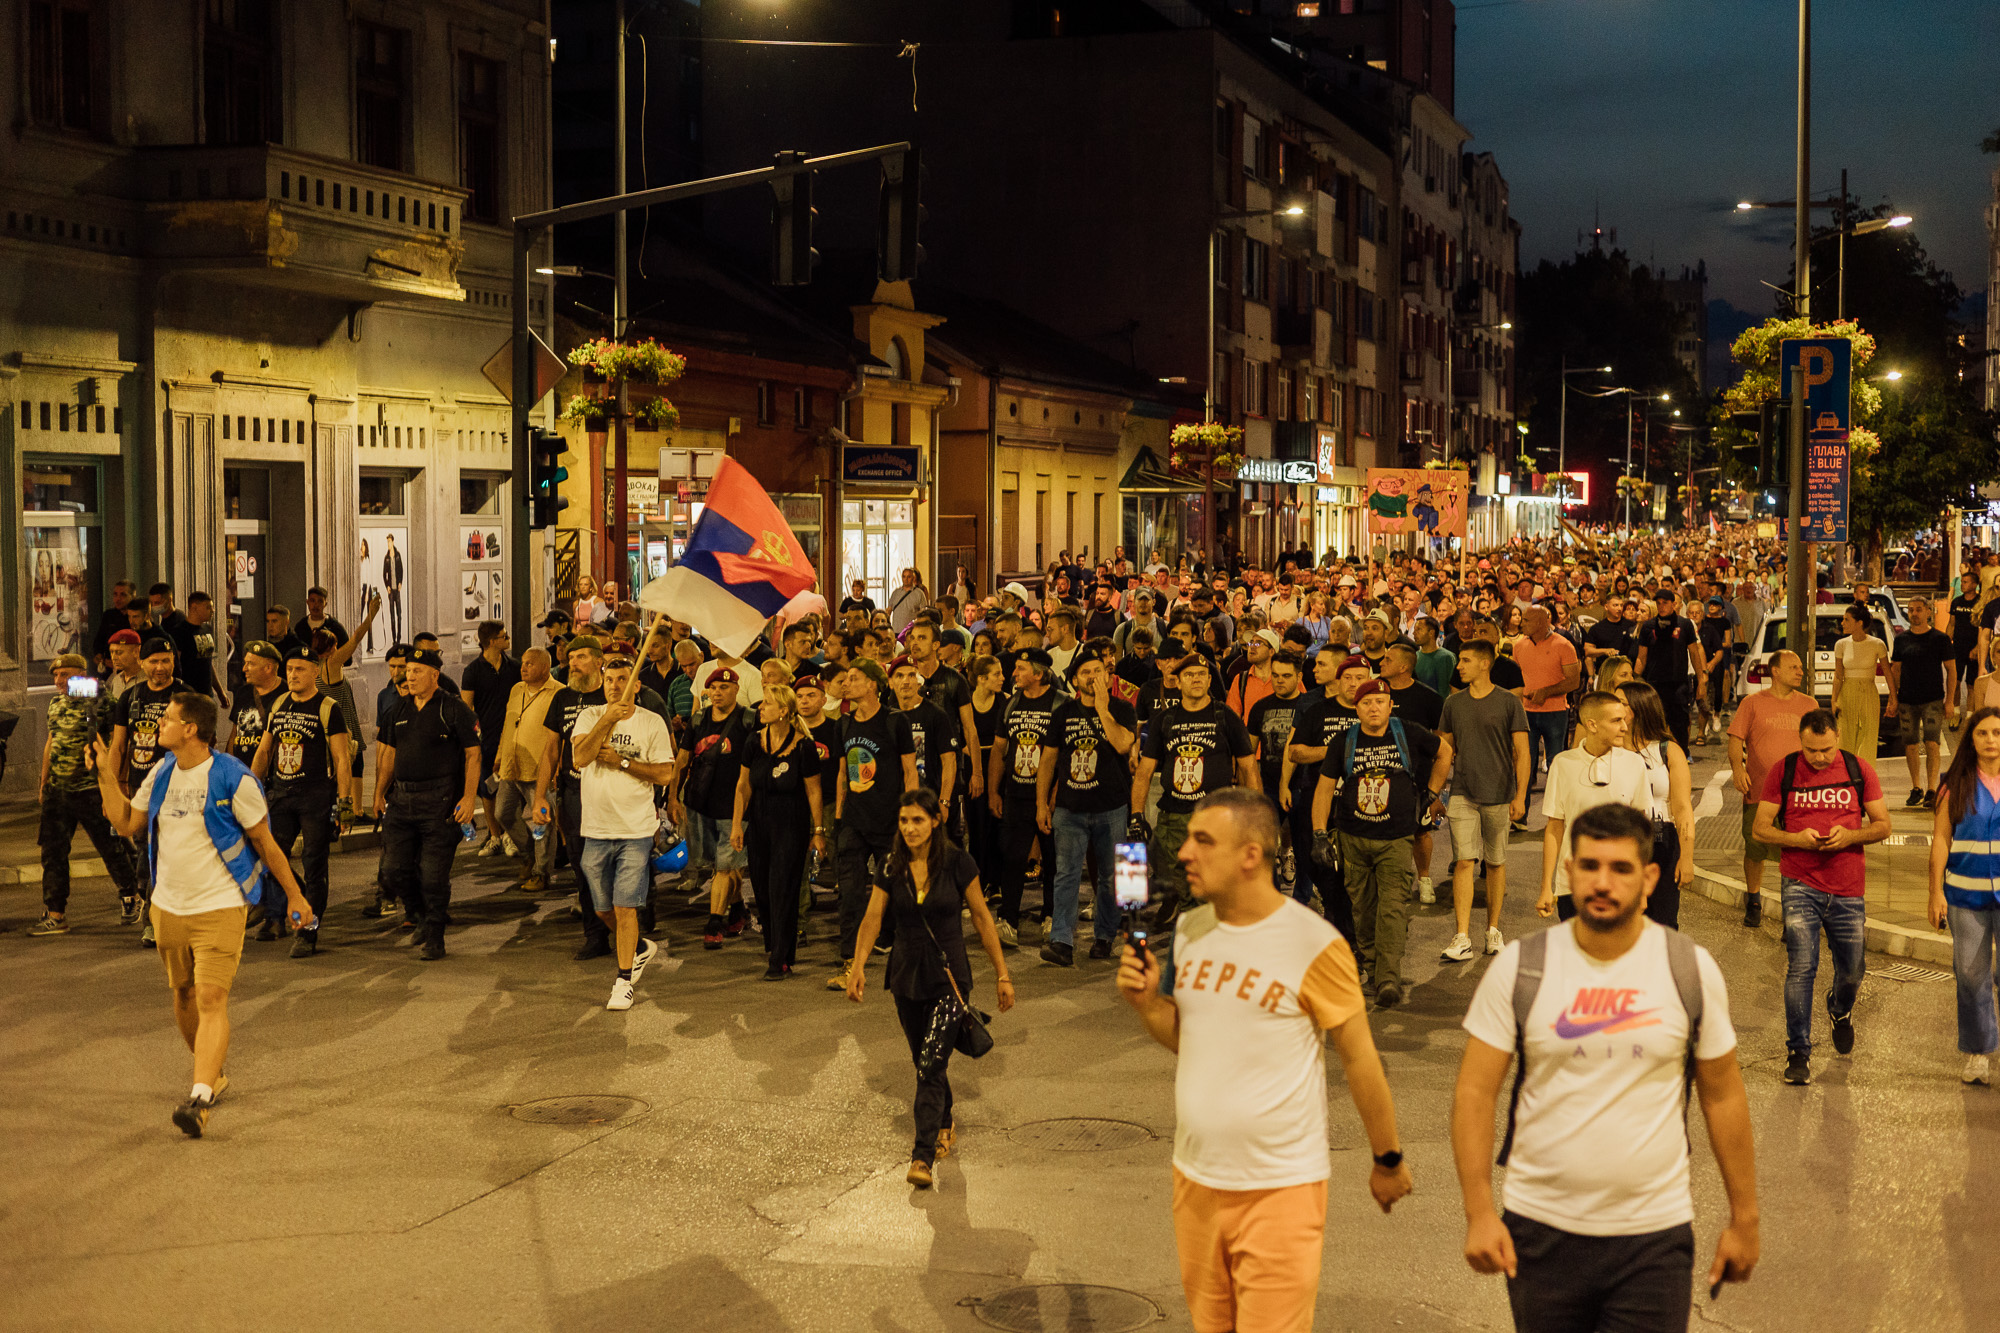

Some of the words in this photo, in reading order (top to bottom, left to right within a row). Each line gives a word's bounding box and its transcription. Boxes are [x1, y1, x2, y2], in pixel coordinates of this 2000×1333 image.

[1800, 346, 1834, 399] P
[1814, 446, 1846, 456] ПЛАВА
[1817, 458, 1842, 469] BLUE
[1020, 723, 1047, 736] ВЕТЕРАН
[857, 736, 880, 753] IZVORA
[1166, 737, 1179, 751] ДАН
[1181, 736, 1216, 749] ВЕТЕРАНА
[1352, 764, 1364, 774] АН
[1366, 760, 1403, 769] ВЕТЕРАН
[1794, 788, 1851, 804] HUGO
[1354, 810, 1390, 823] ВИДОВДАН
[1176, 960, 1285, 1013] EEPER
[1571, 988, 1639, 1014] NIKE
[1573, 1044, 1643, 1058] AIR
